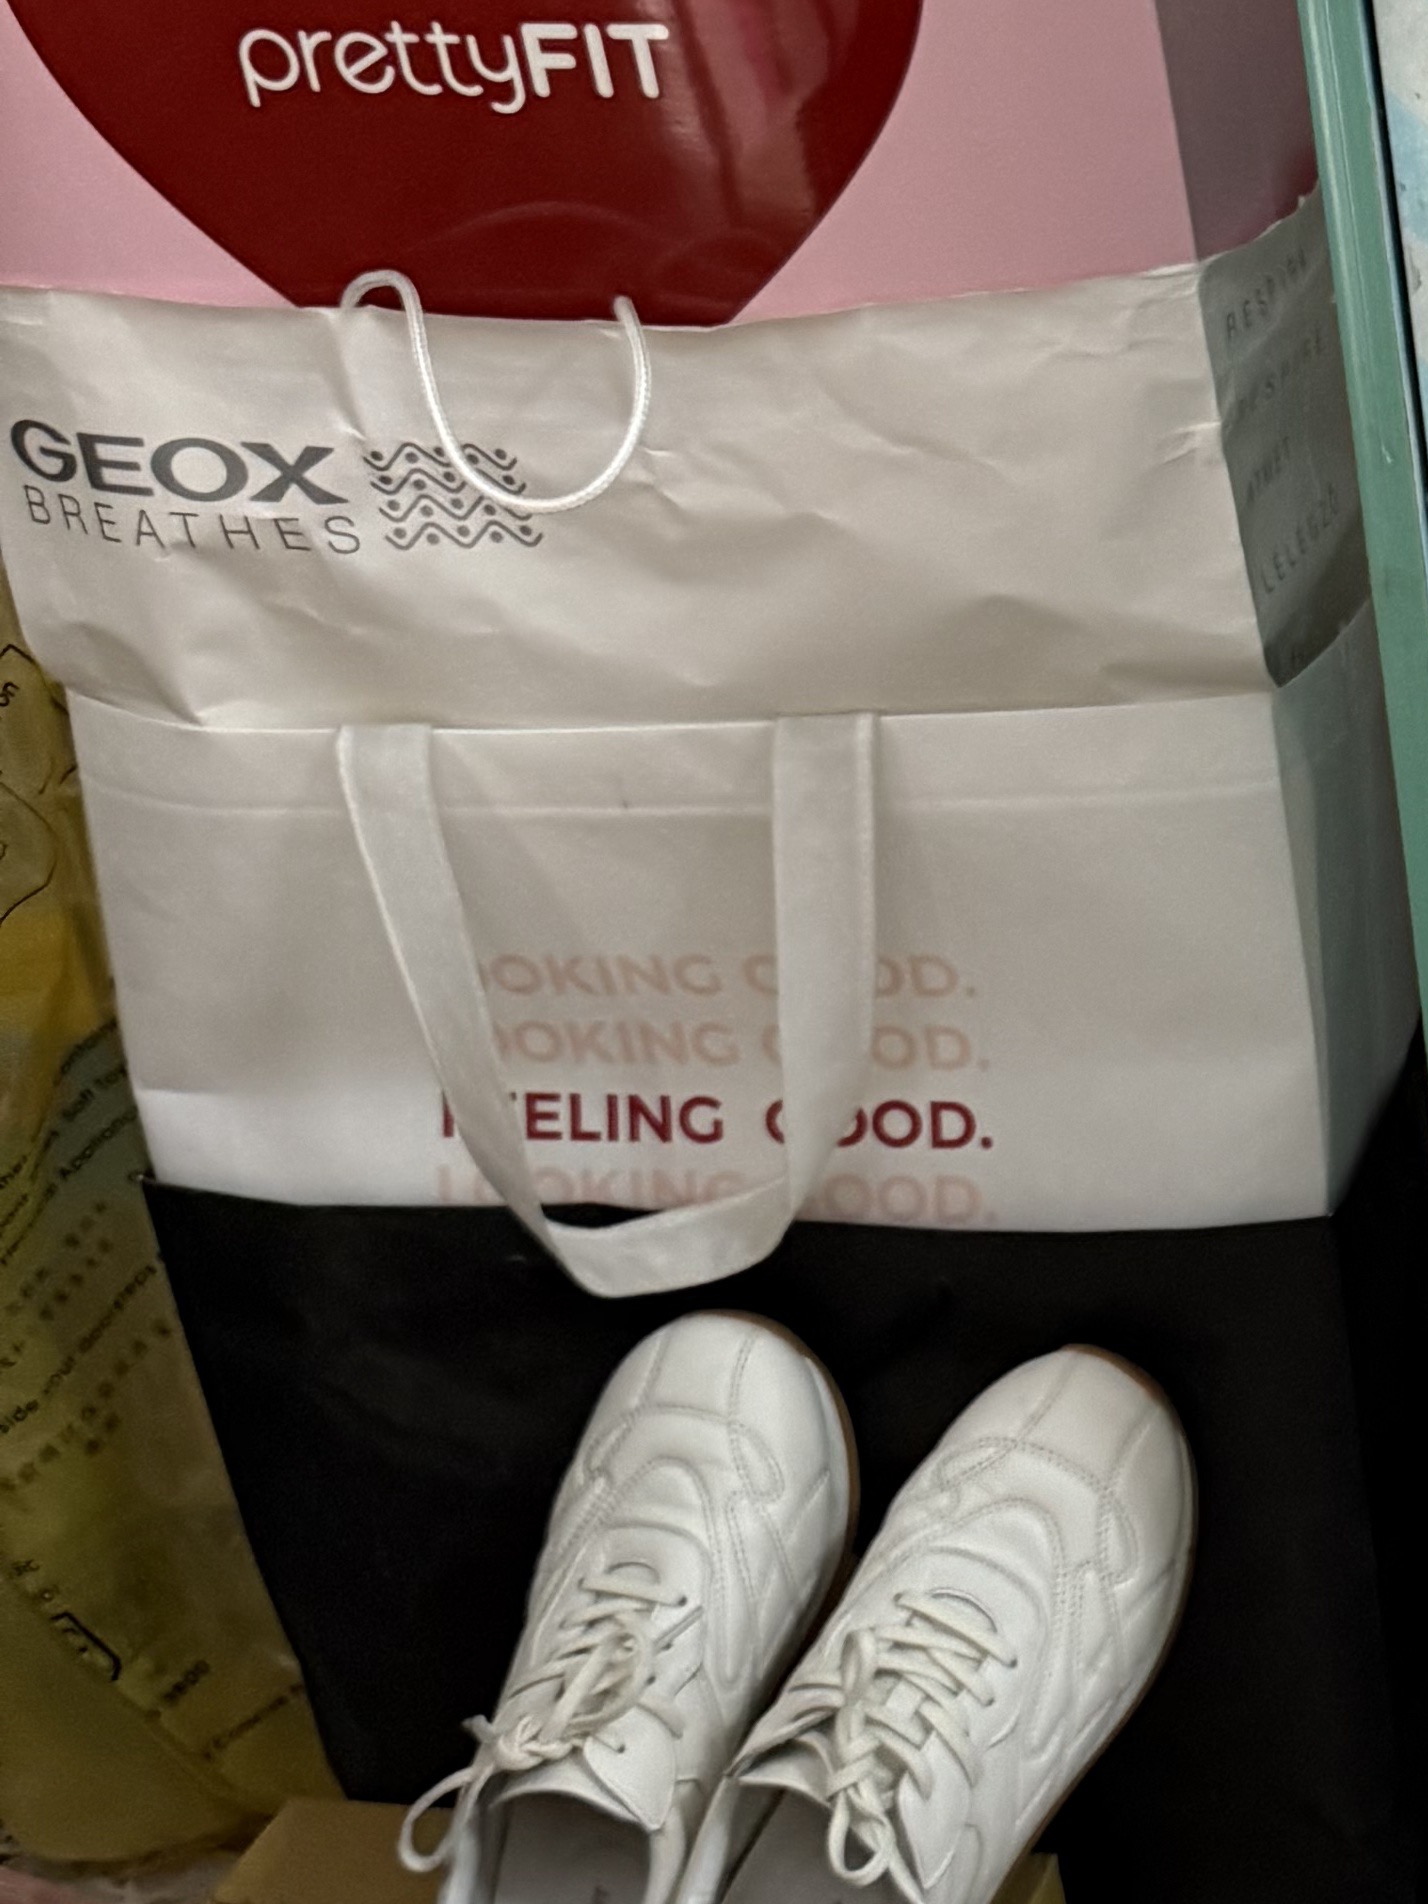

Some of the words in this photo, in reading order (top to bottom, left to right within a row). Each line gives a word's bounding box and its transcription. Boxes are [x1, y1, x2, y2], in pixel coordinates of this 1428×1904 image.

[239, 21, 669, 114] prettyFIT
[11, 419, 349, 505] GEOX
[22, 485, 361, 555] BREATHES
